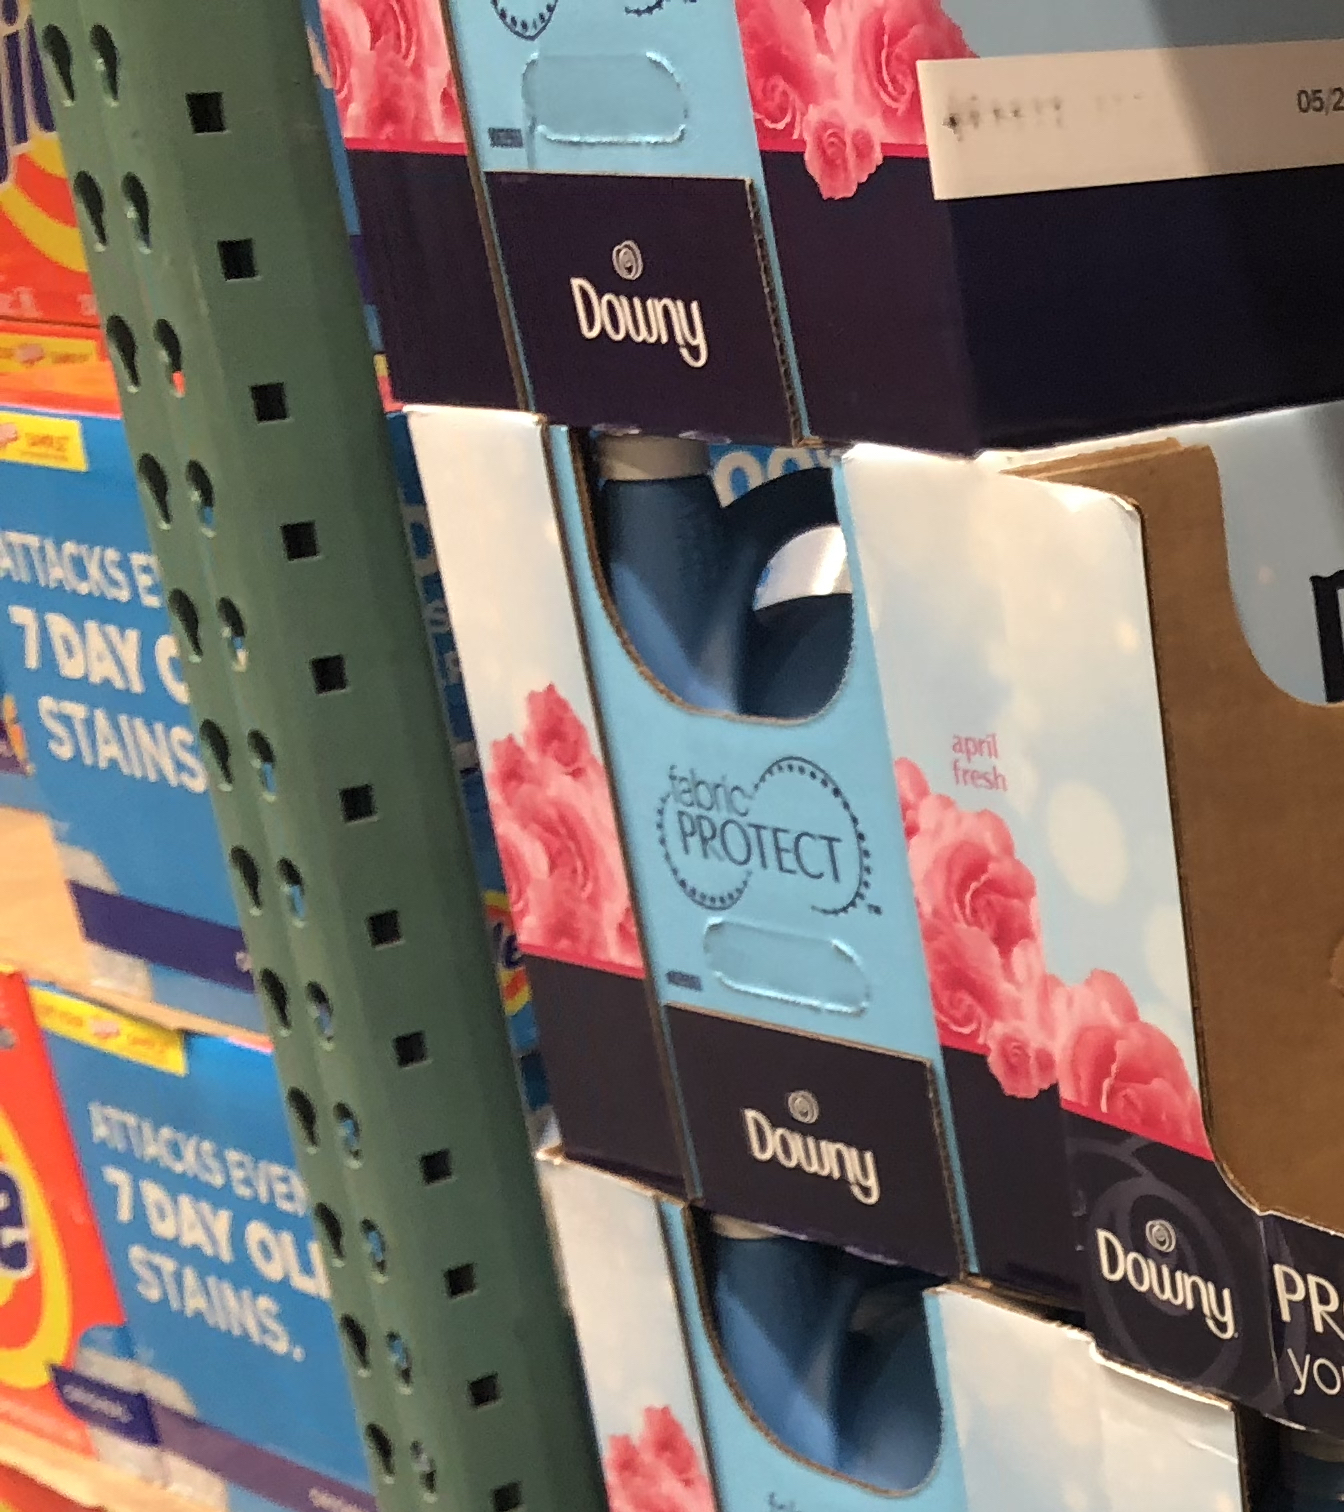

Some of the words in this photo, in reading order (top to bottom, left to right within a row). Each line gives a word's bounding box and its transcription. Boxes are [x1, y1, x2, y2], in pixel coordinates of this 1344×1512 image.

[570, 277, 708, 369] Downy
[8, 604, 41, 671] 7
[44, 611, 146, 695] DAY
[38, 695, 209, 795] STAINS
[951, 730, 999, 762] april
[951, 761, 1009, 793] fresh
[678, 818, 844, 885] PROTECT
[742, 1106, 881, 1207] Downy
[103, 1166, 134, 1224] 7
[139, 1177, 234, 1264] DAY
[245, 1219, 333, 1300] OL
[128, 1244, 306, 1362] STAINS.
[1096, 1227, 1240, 1341] Downy
